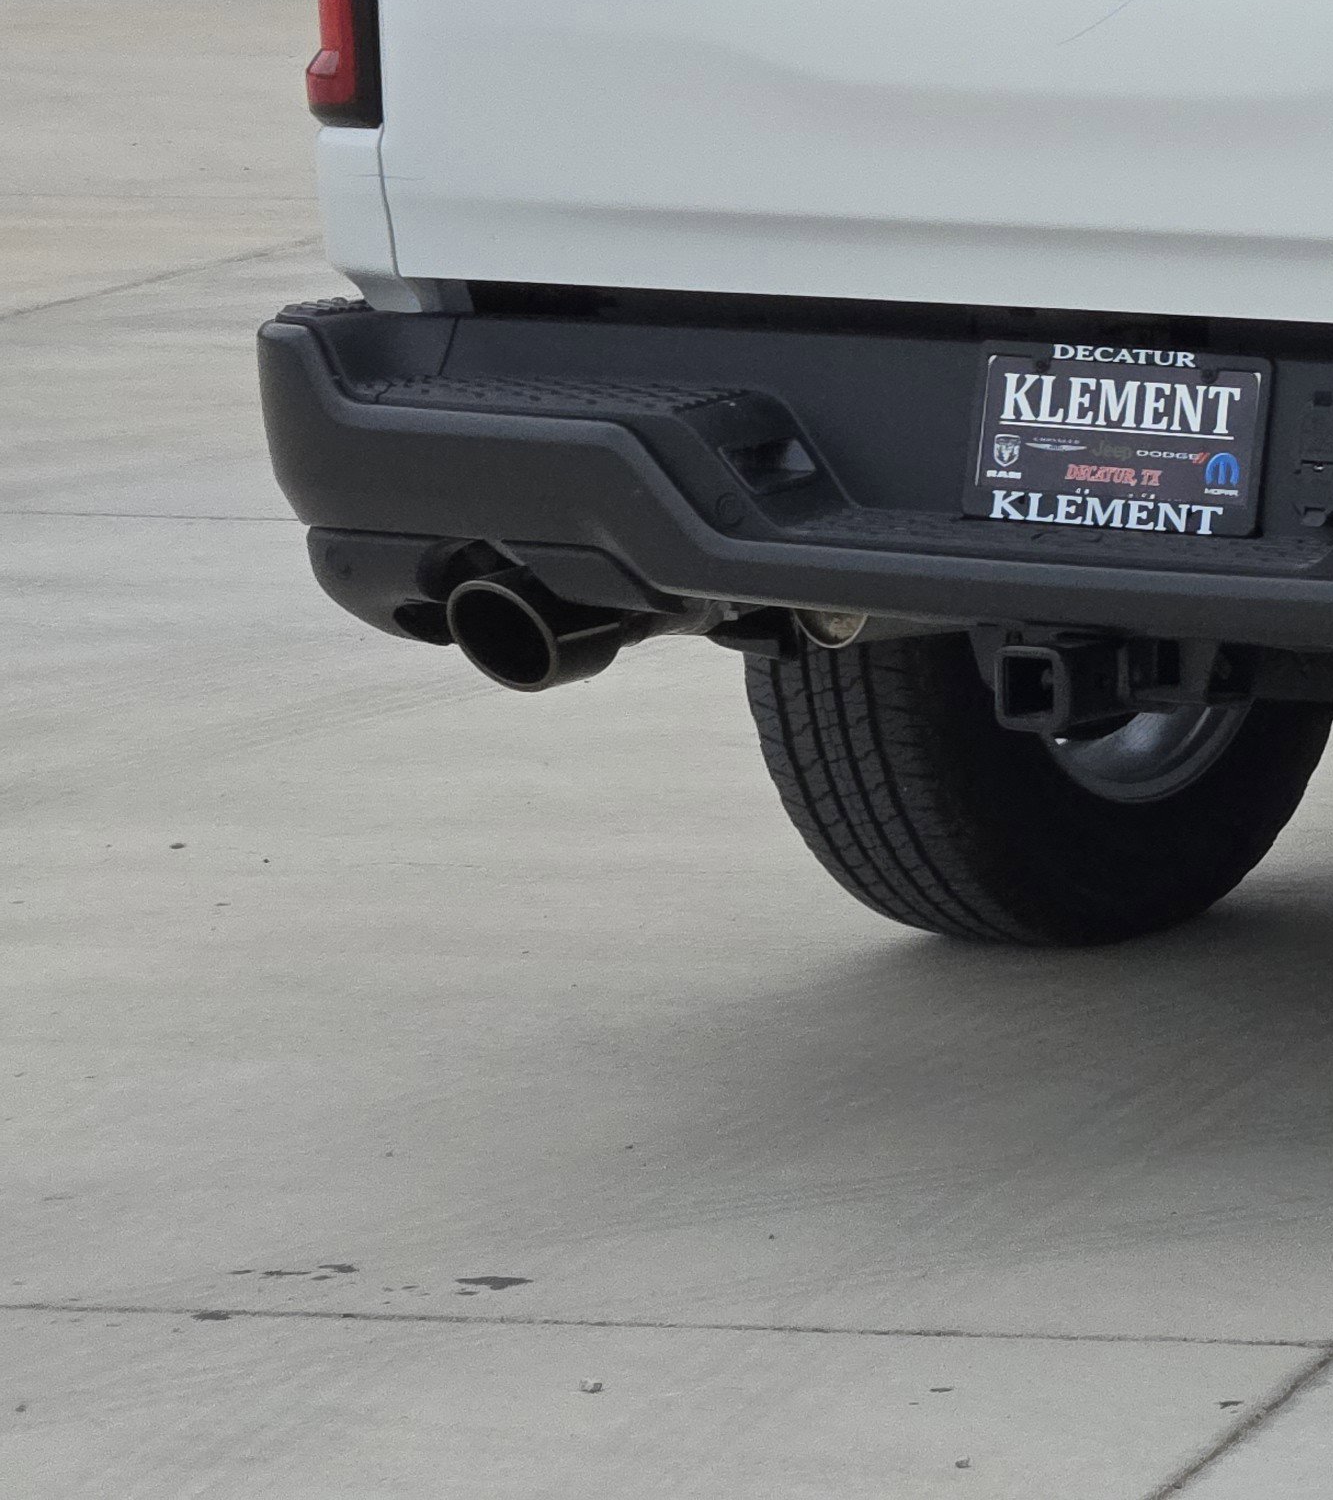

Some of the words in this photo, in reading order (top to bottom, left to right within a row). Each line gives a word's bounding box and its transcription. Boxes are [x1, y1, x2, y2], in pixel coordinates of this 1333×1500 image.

[1053, 343, 1196, 368] DECATUR
[1000, 372, 1241, 434] KLEMENT
[1091, 440, 1133, 461] Jeep
[1136, 449, 1199, 461] DODGE
[986, 469, 1022, 479] RAM
[1065, 463, 1138, 485] DECATUR,
[1141, 467, 1162, 486] TX
[989, 490, 1224, 535] KLEMENT
